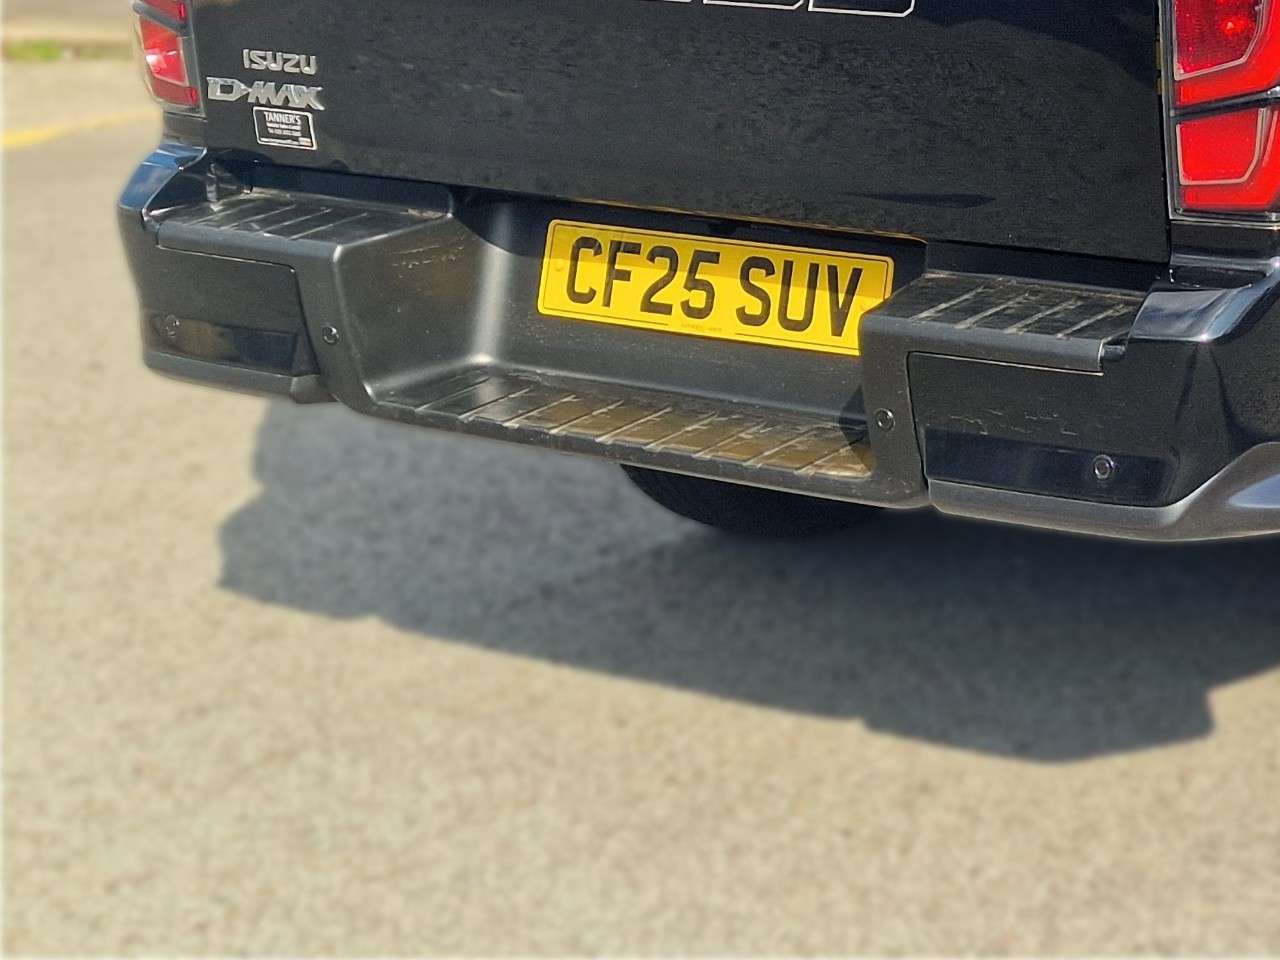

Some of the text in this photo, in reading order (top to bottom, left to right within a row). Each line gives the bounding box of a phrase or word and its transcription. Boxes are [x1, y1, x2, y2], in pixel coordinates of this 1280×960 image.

[242, 48, 317, 74] ISUZU
[206, 76, 325, 110] D-MAX
[263, 111, 301, 124] TANNER'S
[565, 236, 864, 338] CF25 SUV
